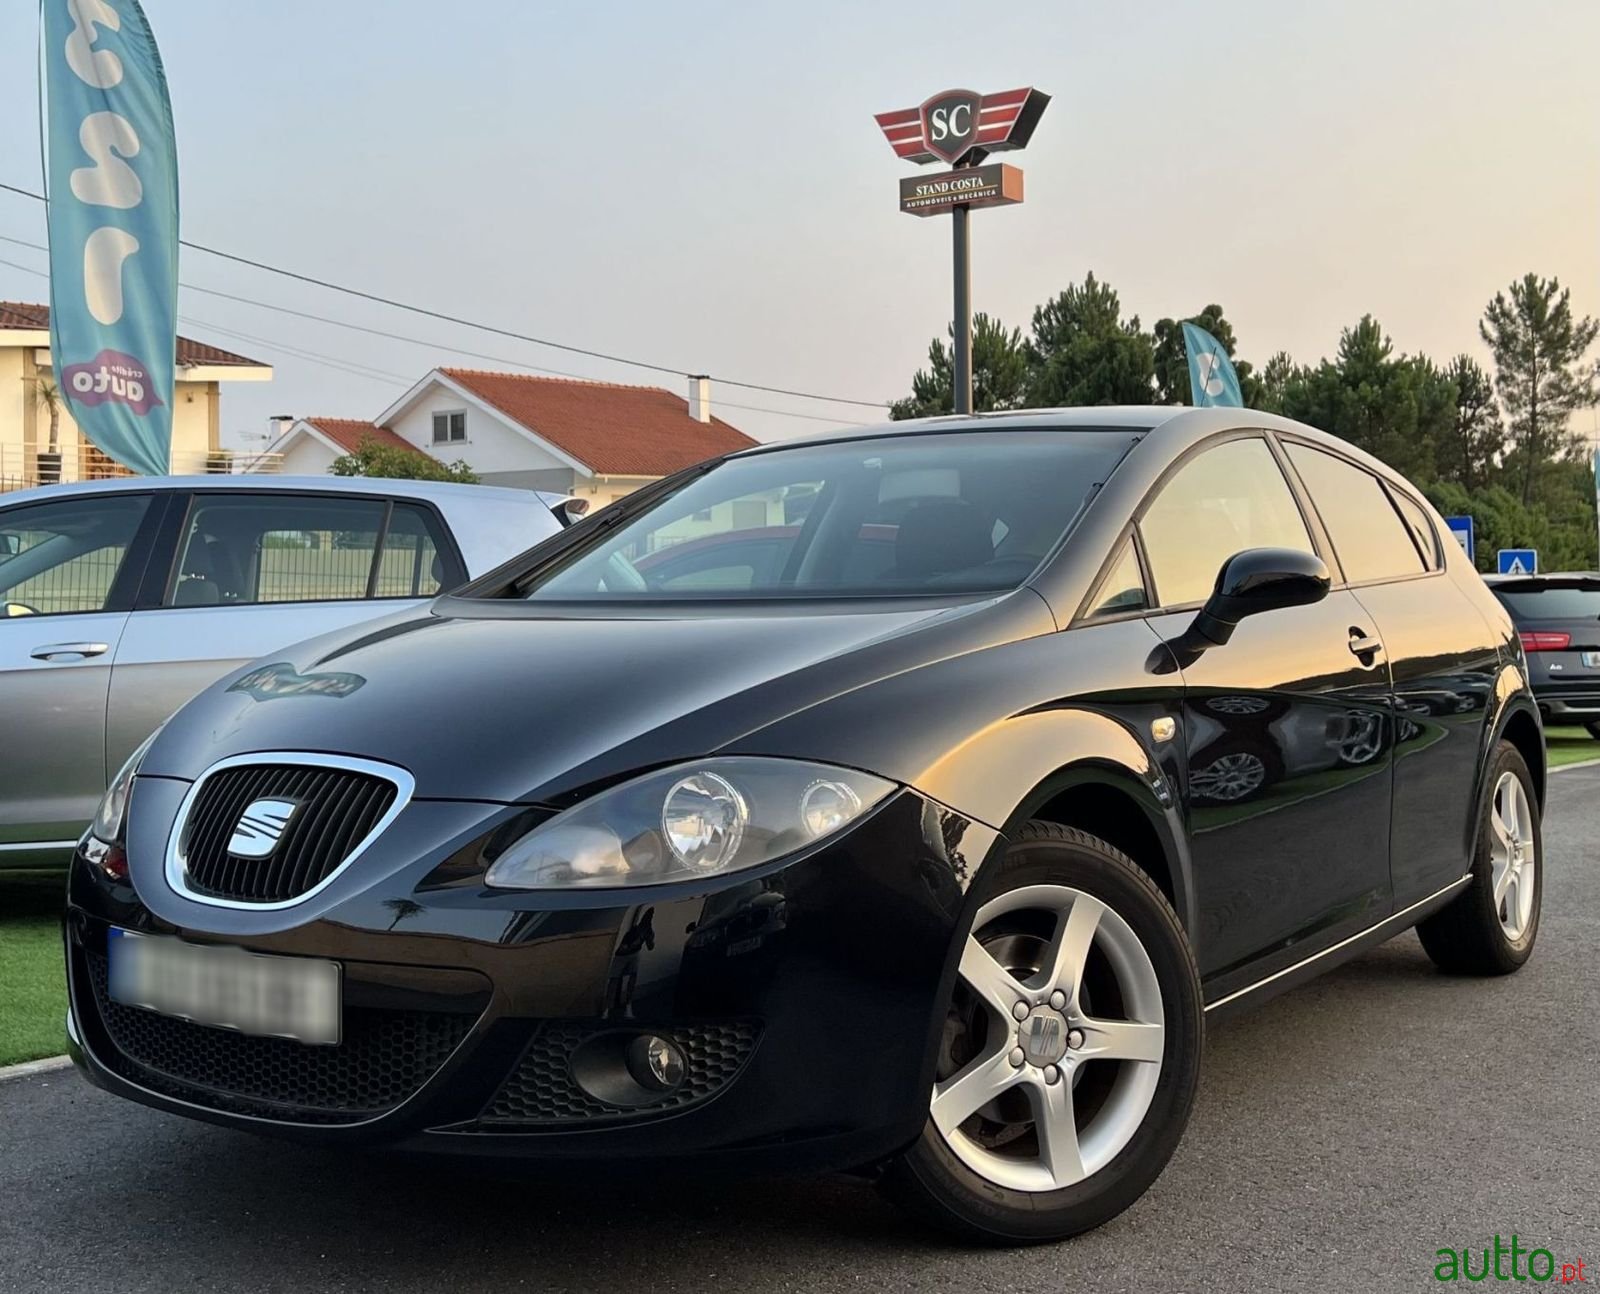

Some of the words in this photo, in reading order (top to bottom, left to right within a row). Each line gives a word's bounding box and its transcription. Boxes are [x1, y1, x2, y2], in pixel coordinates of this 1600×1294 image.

[931, 103, 971, 141] SC
[916, 181, 949, 196] STAND
[950, 177, 984, 190] COSTA
[906, 196, 952, 208] AUTOMÓVEIS
[958, 189, 996, 200] MECÂNICA
